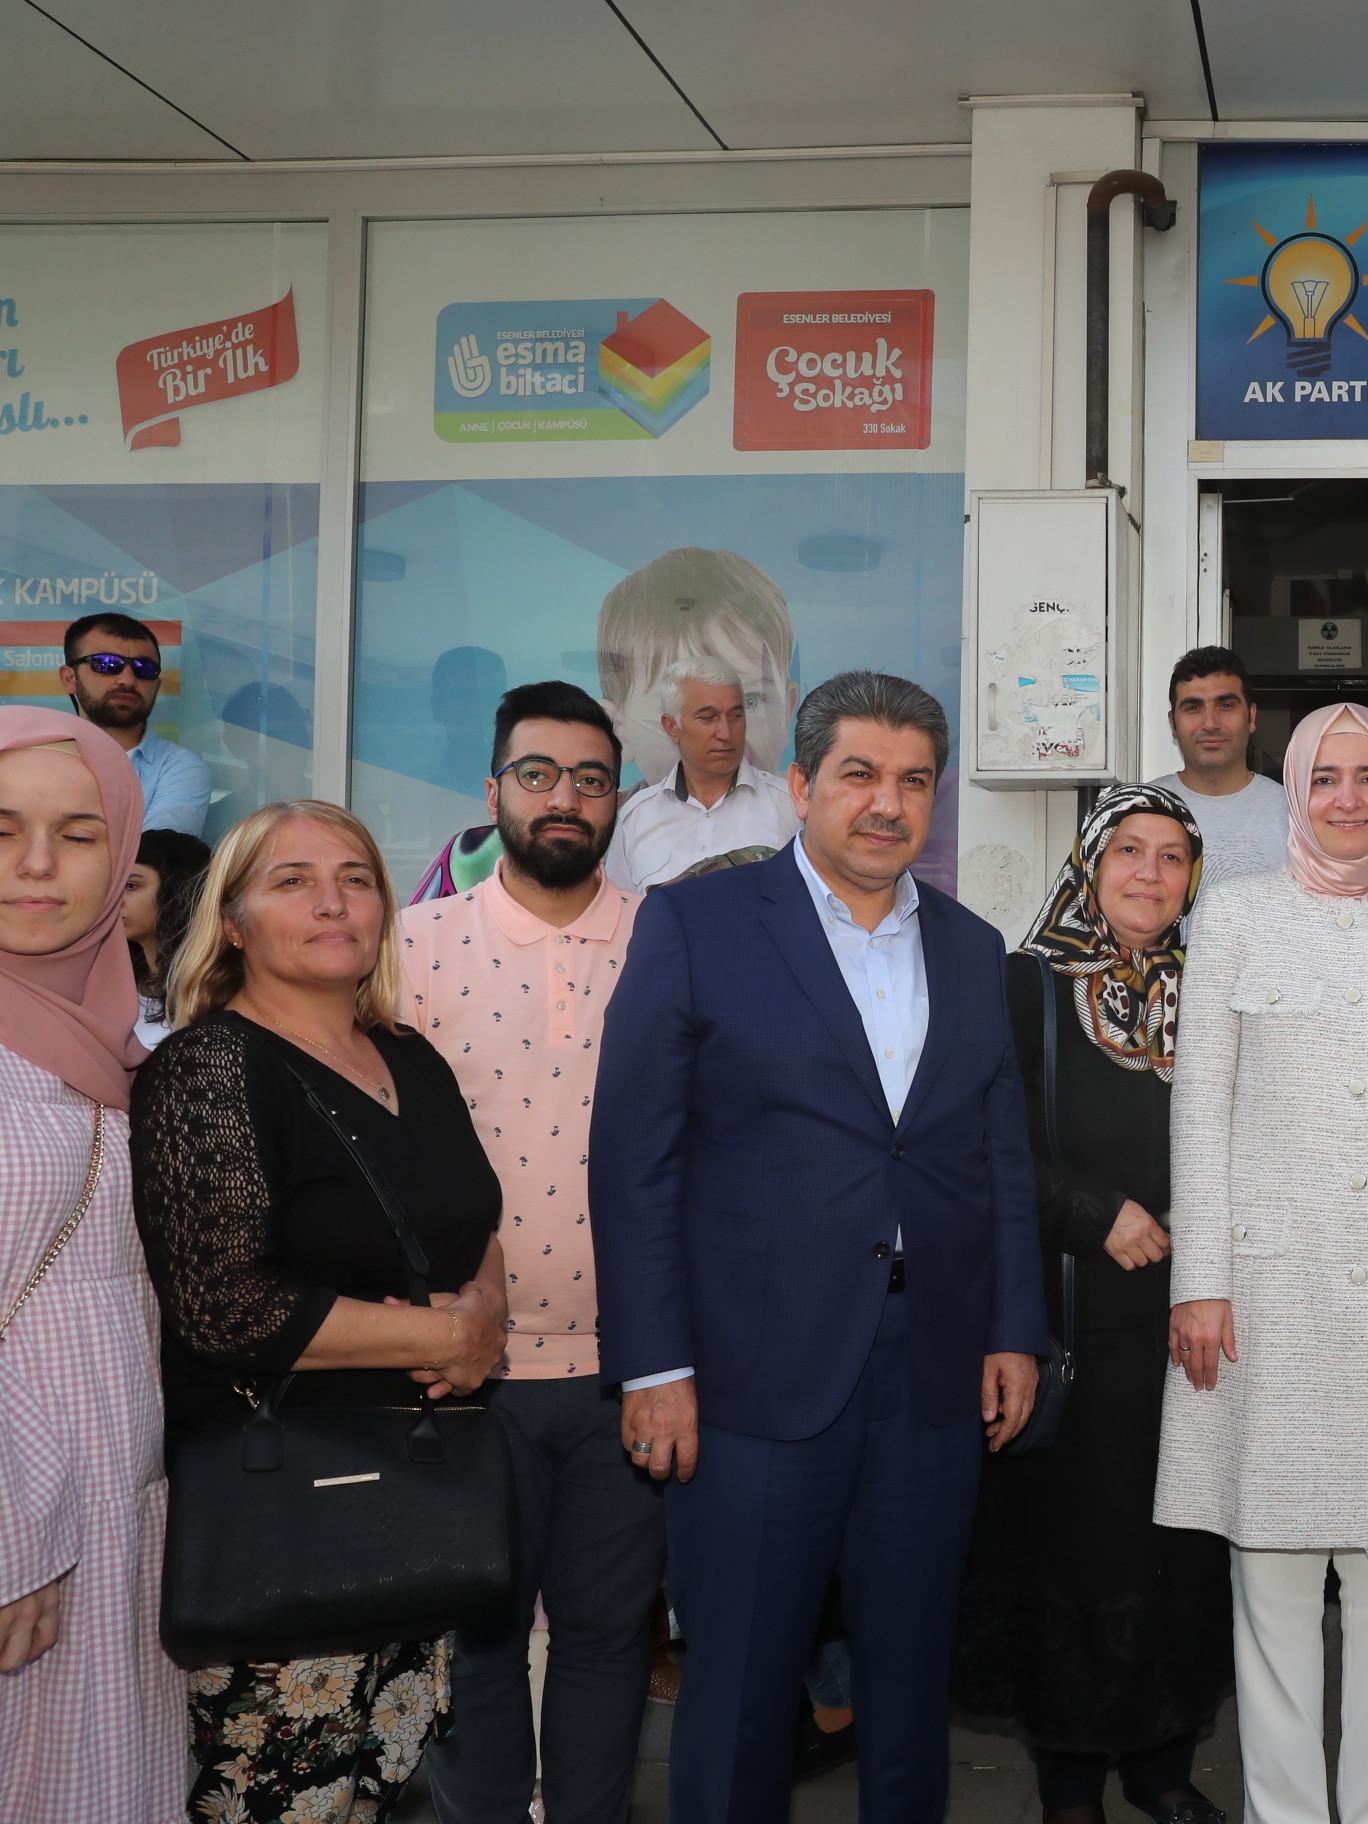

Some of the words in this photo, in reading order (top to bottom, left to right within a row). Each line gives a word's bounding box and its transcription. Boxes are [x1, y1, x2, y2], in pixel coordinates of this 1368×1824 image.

[783, 314, 831, 324] ESENLER
[832, 311, 892, 323] BELEDİYESİ
[146, 321, 255, 371] Türkiye'de
[497, 331, 535, 340] ESENLER
[536, 328, 585, 339] BELEDİYESİ
[496, 340, 586, 366] esma
[158, 364, 213, 404] Bir
[218, 341, 269, 384] İlk
[500, 366, 586, 396] biltaci
[766, 337, 903, 398] Çocuk
[793, 379, 904, 413] Sokağı
[1243, 381, 1285, 403] AK
[459, 423, 489, 432] ANNE
[498, 420, 532, 432] ÇOCUK
[537, 418, 588, 430] KAMPÜSÜ
[863, 423, 878, 434] 330
[880, 422, 906, 434] Sokak
[14, 571, 159, 605] KAMPÜSÜ
